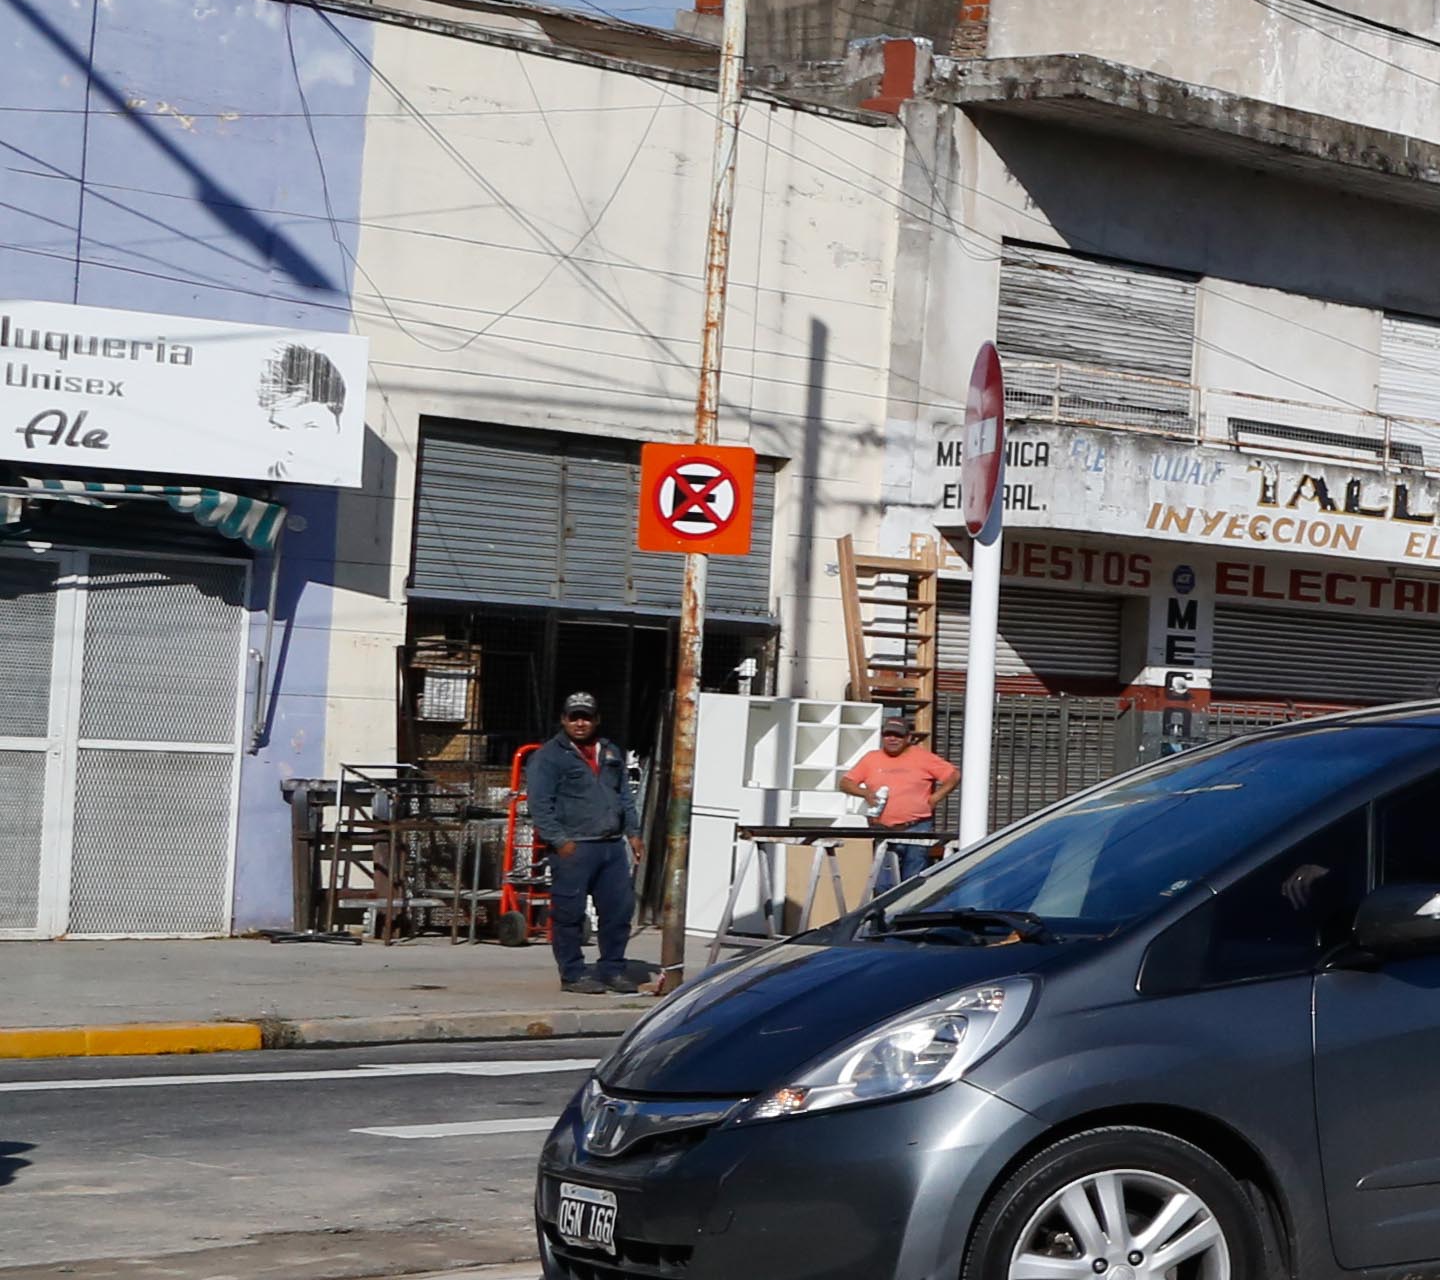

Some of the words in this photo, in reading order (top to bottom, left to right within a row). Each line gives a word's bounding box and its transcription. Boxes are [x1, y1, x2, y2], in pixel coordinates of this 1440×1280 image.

[6, 363, 125, 397] Unisex
[15, 409, 110, 449] Ale
[937, 441, 1049, 467] MENICA
[1146, 502, 1363, 552] INYECCION
[560, 1199, 585, 1237] OSN
[588, 1205, 613, 1244] 166
